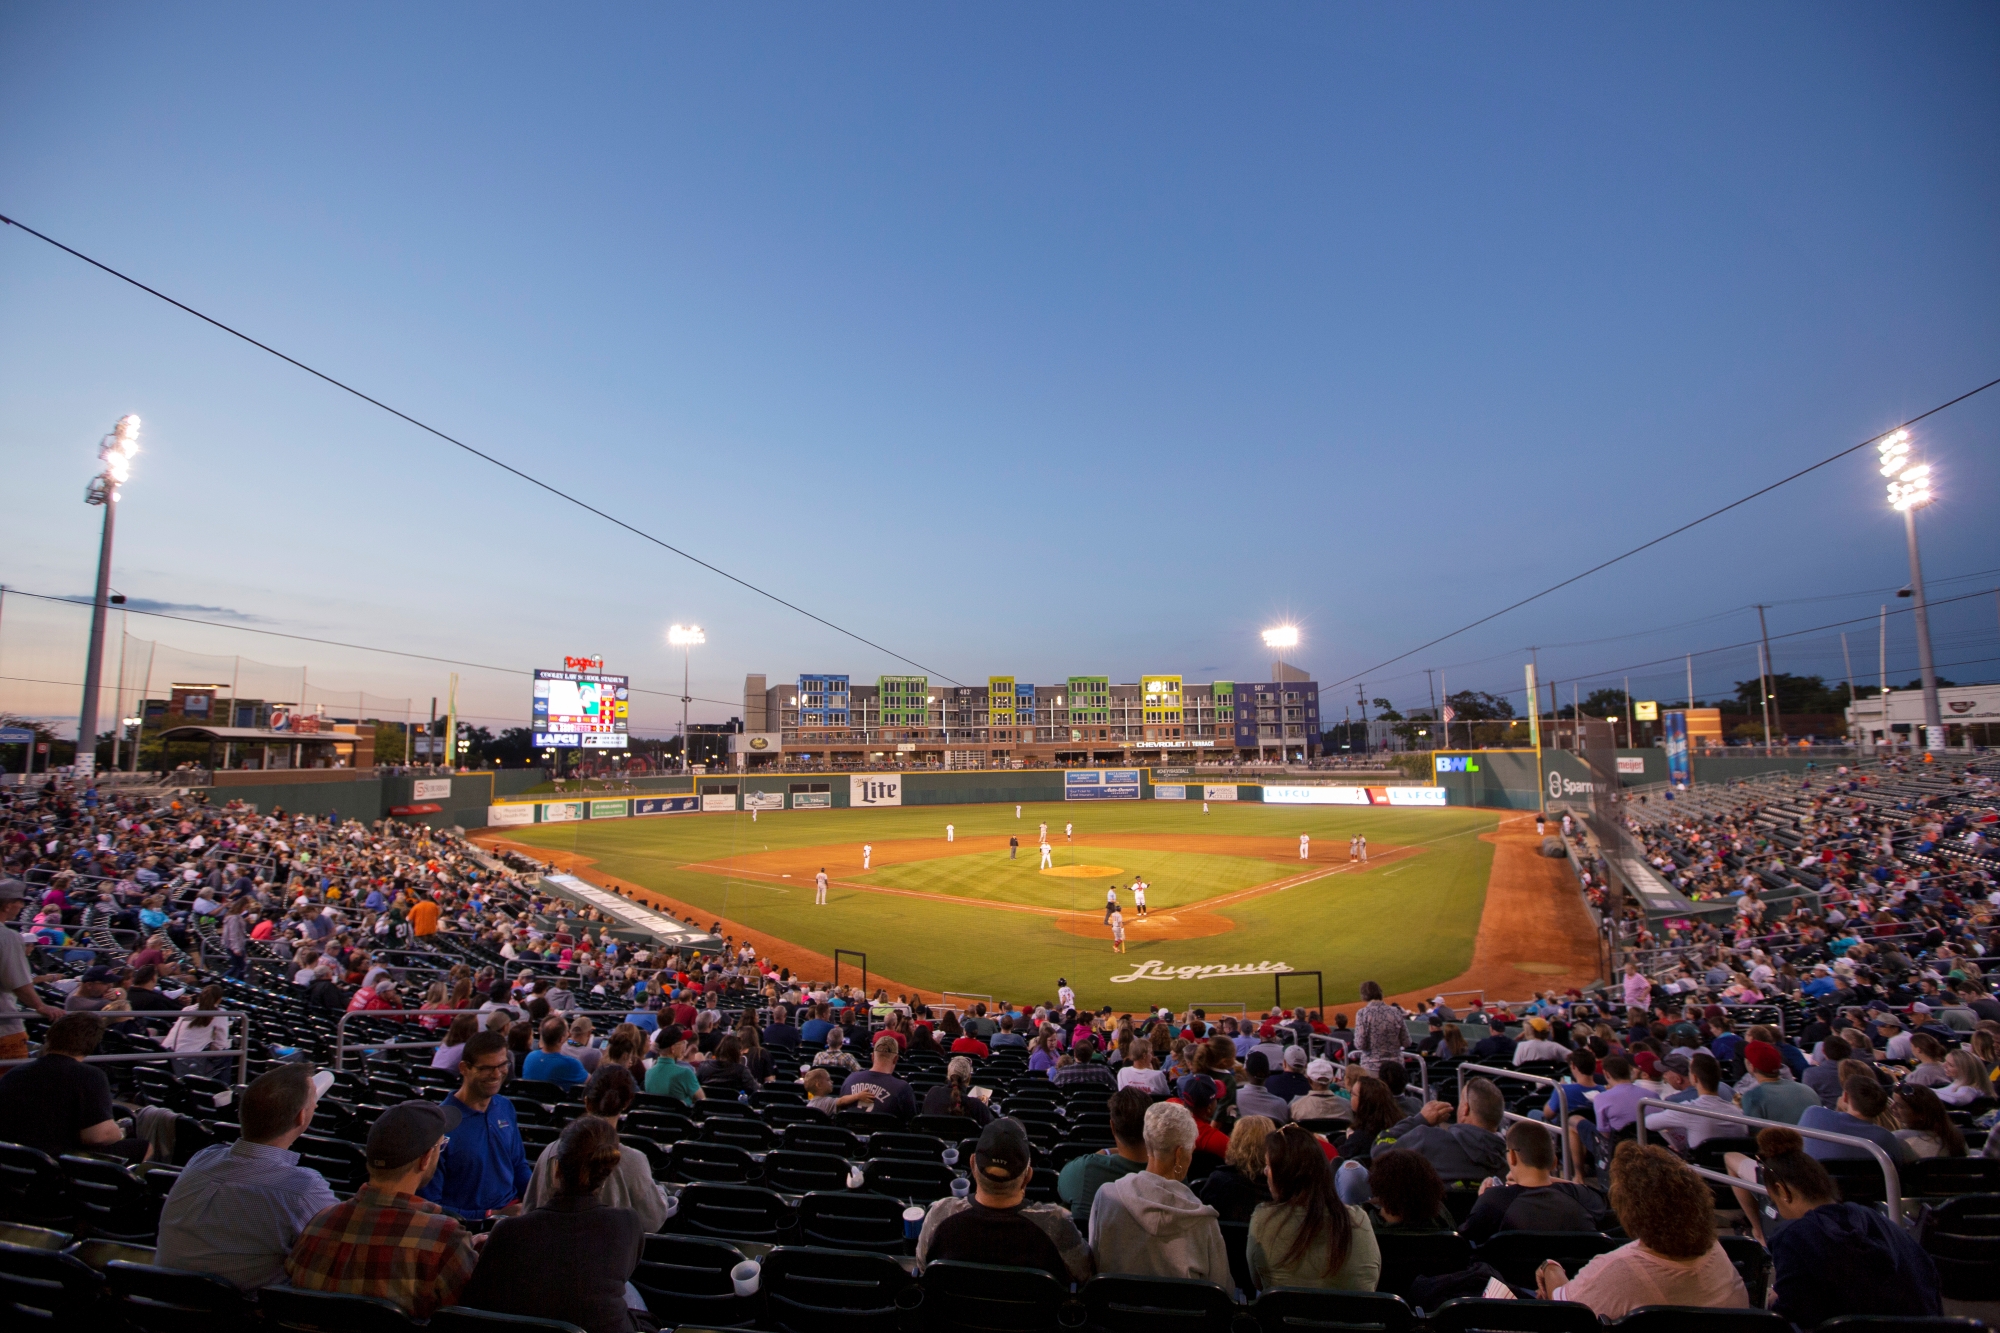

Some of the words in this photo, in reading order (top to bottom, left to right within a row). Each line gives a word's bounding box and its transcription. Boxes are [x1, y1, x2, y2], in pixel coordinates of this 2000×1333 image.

[540, 671, 563, 680] COOLEY
[577, 673, 600, 682] SCHOOL
[600, 675, 624, 684] STADIUM
[536, 733, 579, 744] LAFCU
[1436, 756, 1479, 772] BWL
[1617, 759, 1643, 772] meijer
[861, 781, 897, 804] Lite
[1563, 778, 1608, 796] Sparrow
[1110, 960, 1294, 983] Lugnuts
[851, 1082, 891, 1104] RODRIGUEZ
